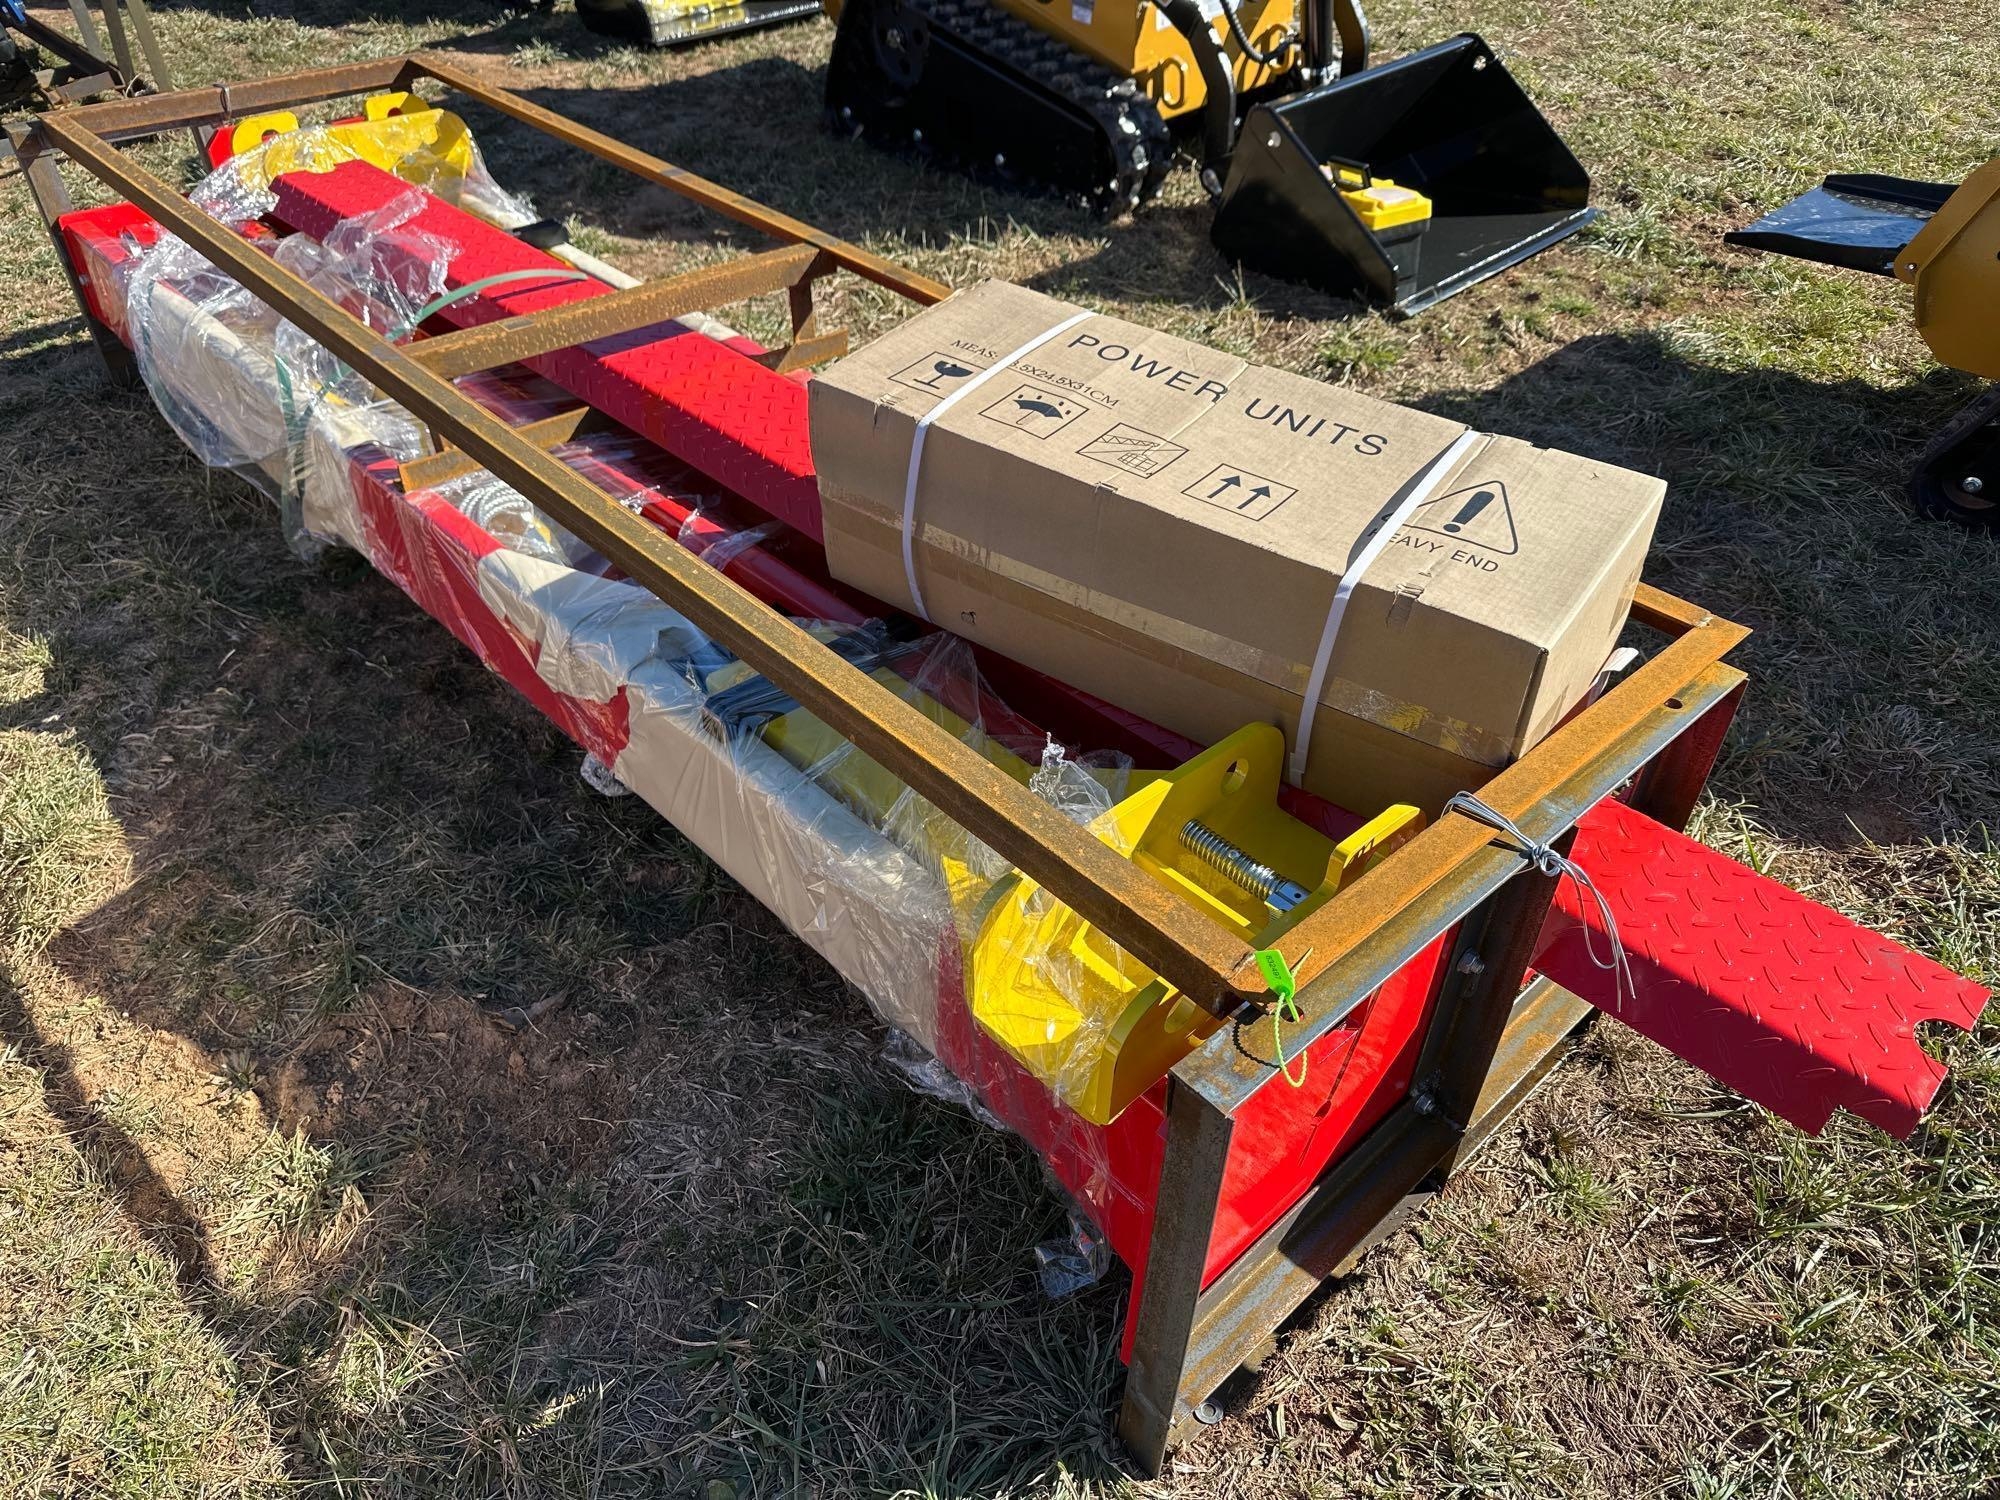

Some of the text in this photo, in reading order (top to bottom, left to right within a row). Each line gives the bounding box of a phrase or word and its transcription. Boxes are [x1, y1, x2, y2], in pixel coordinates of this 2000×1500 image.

[950, 339, 999, 360] MEAS:
[1067, 334, 1389, 456] POWER UNITS
[1450, 549, 1499, 573] END
